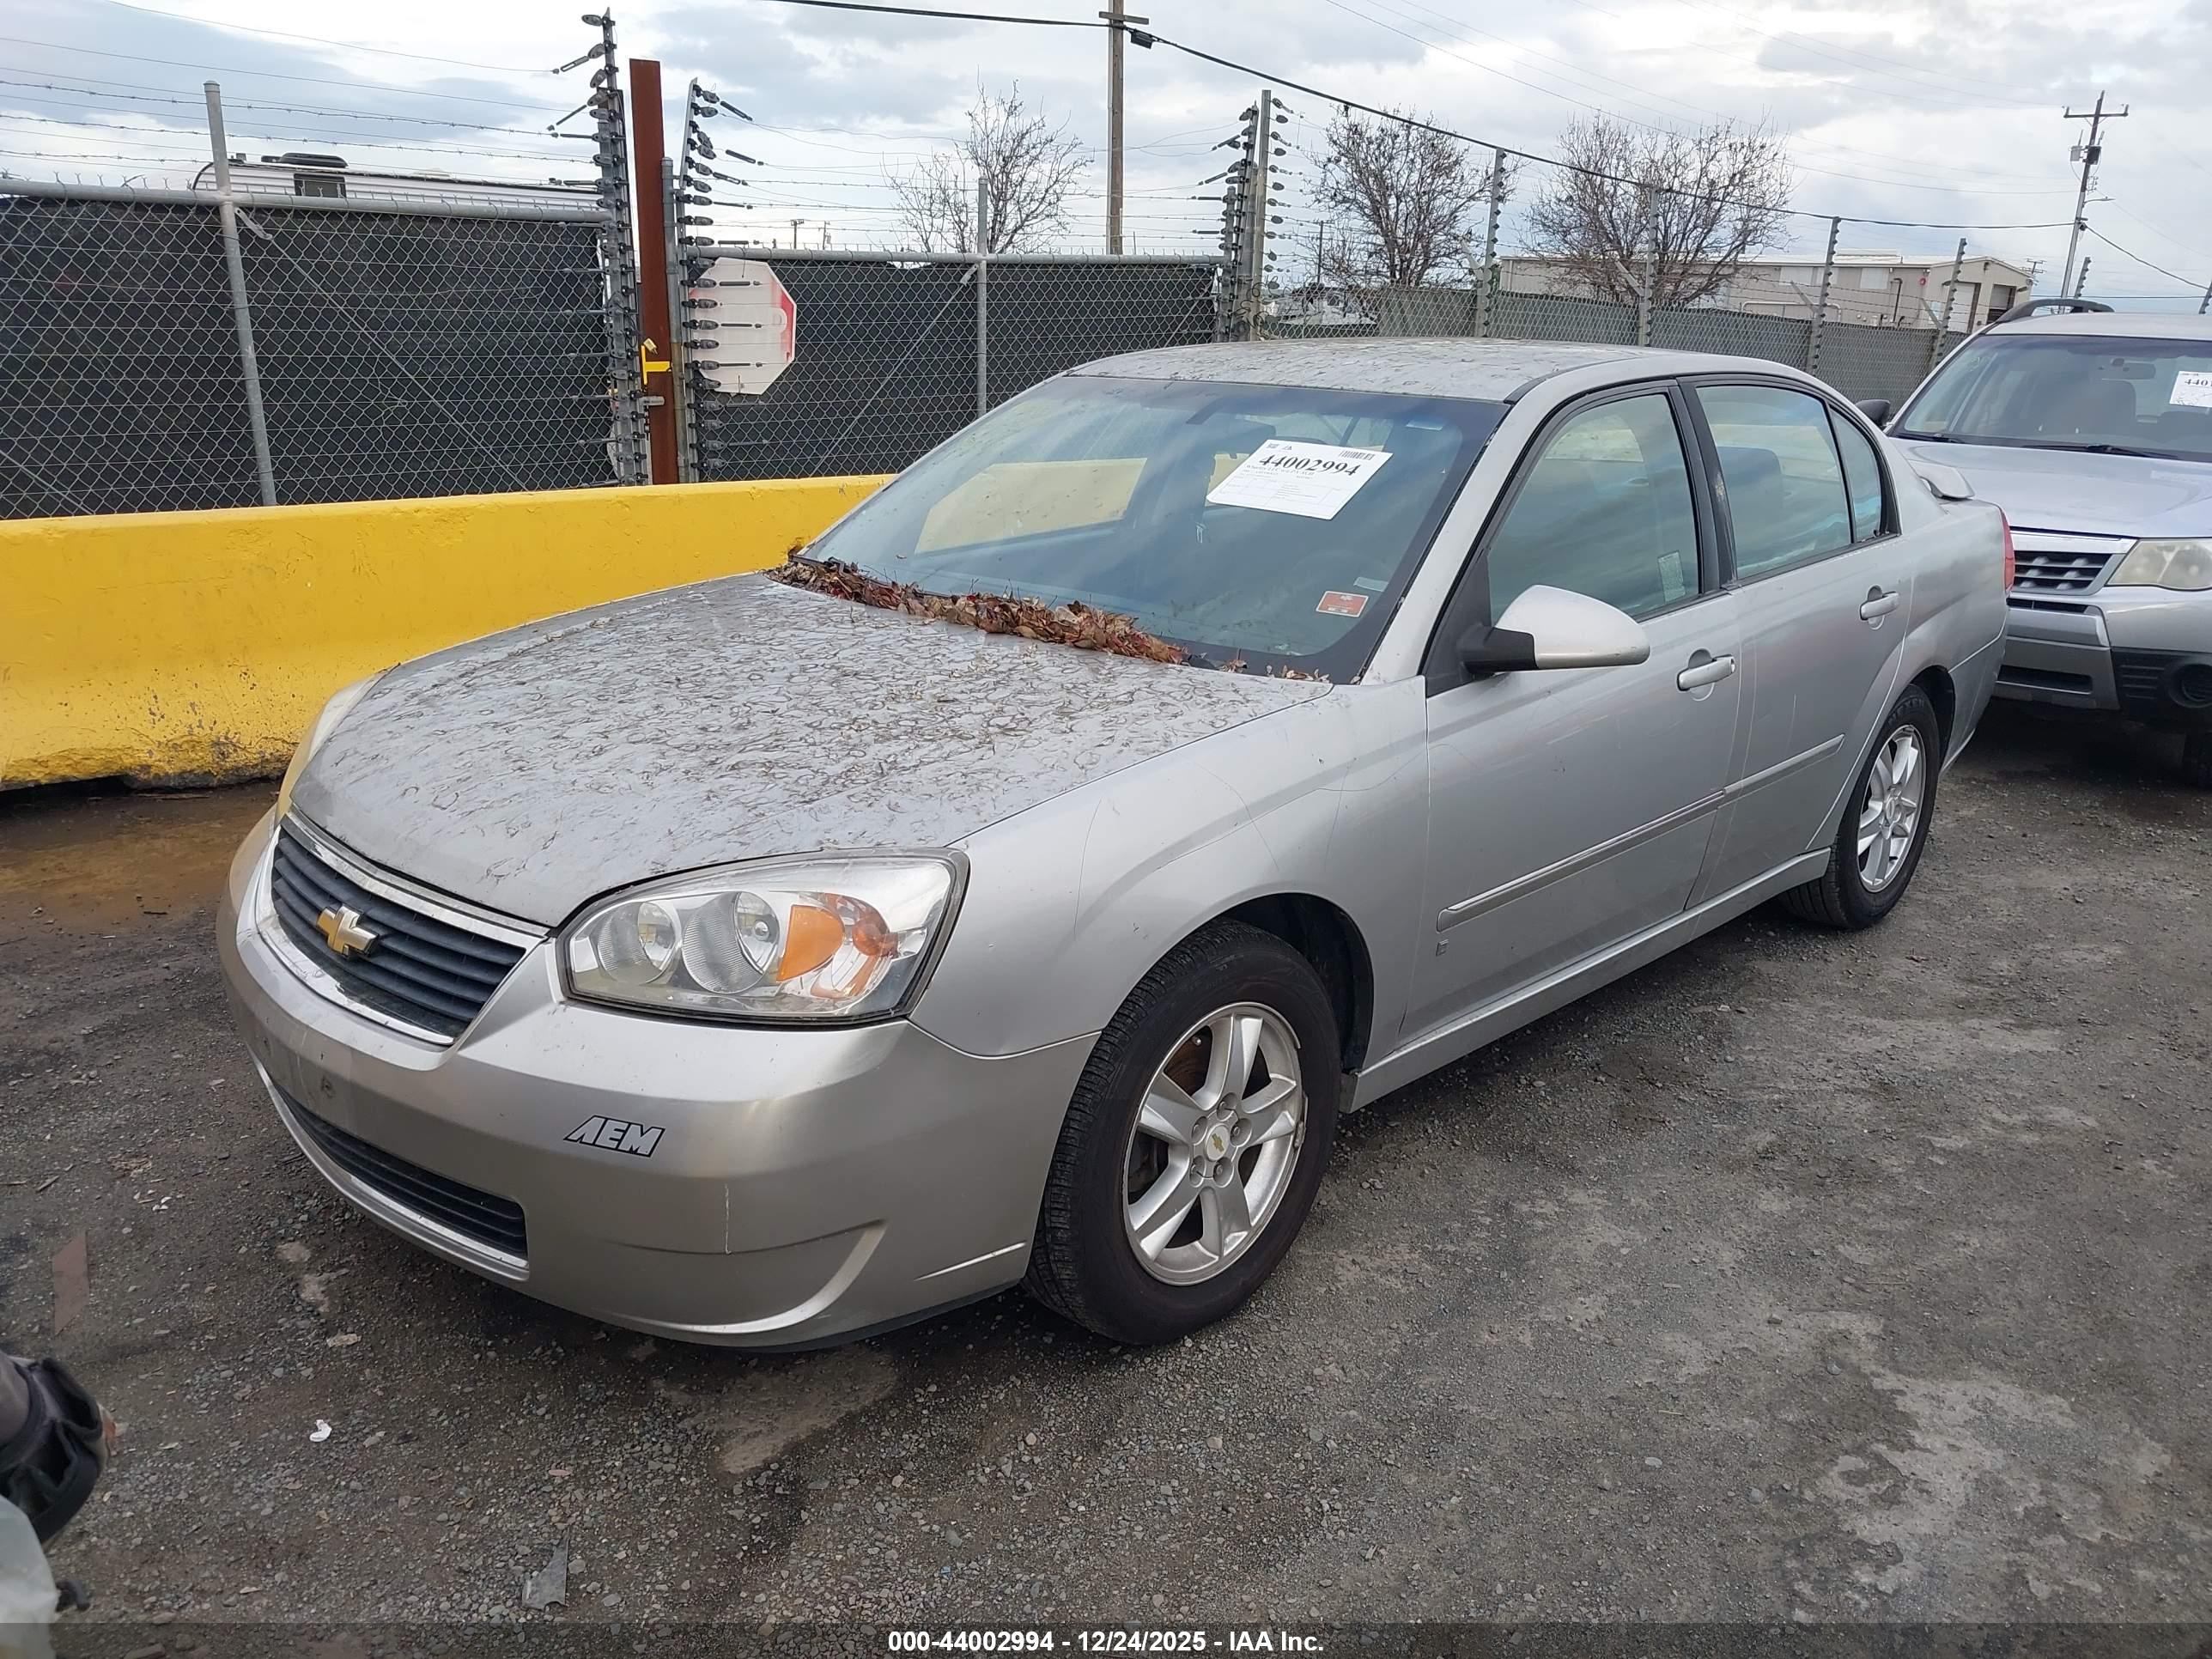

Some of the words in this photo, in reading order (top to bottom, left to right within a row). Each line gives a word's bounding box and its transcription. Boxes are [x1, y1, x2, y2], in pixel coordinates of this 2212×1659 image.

[2185, 378, 2212, 386] 440
[1259, 453, 1361, 477] 44002994
[563, 1115, 666, 1158] AEM
